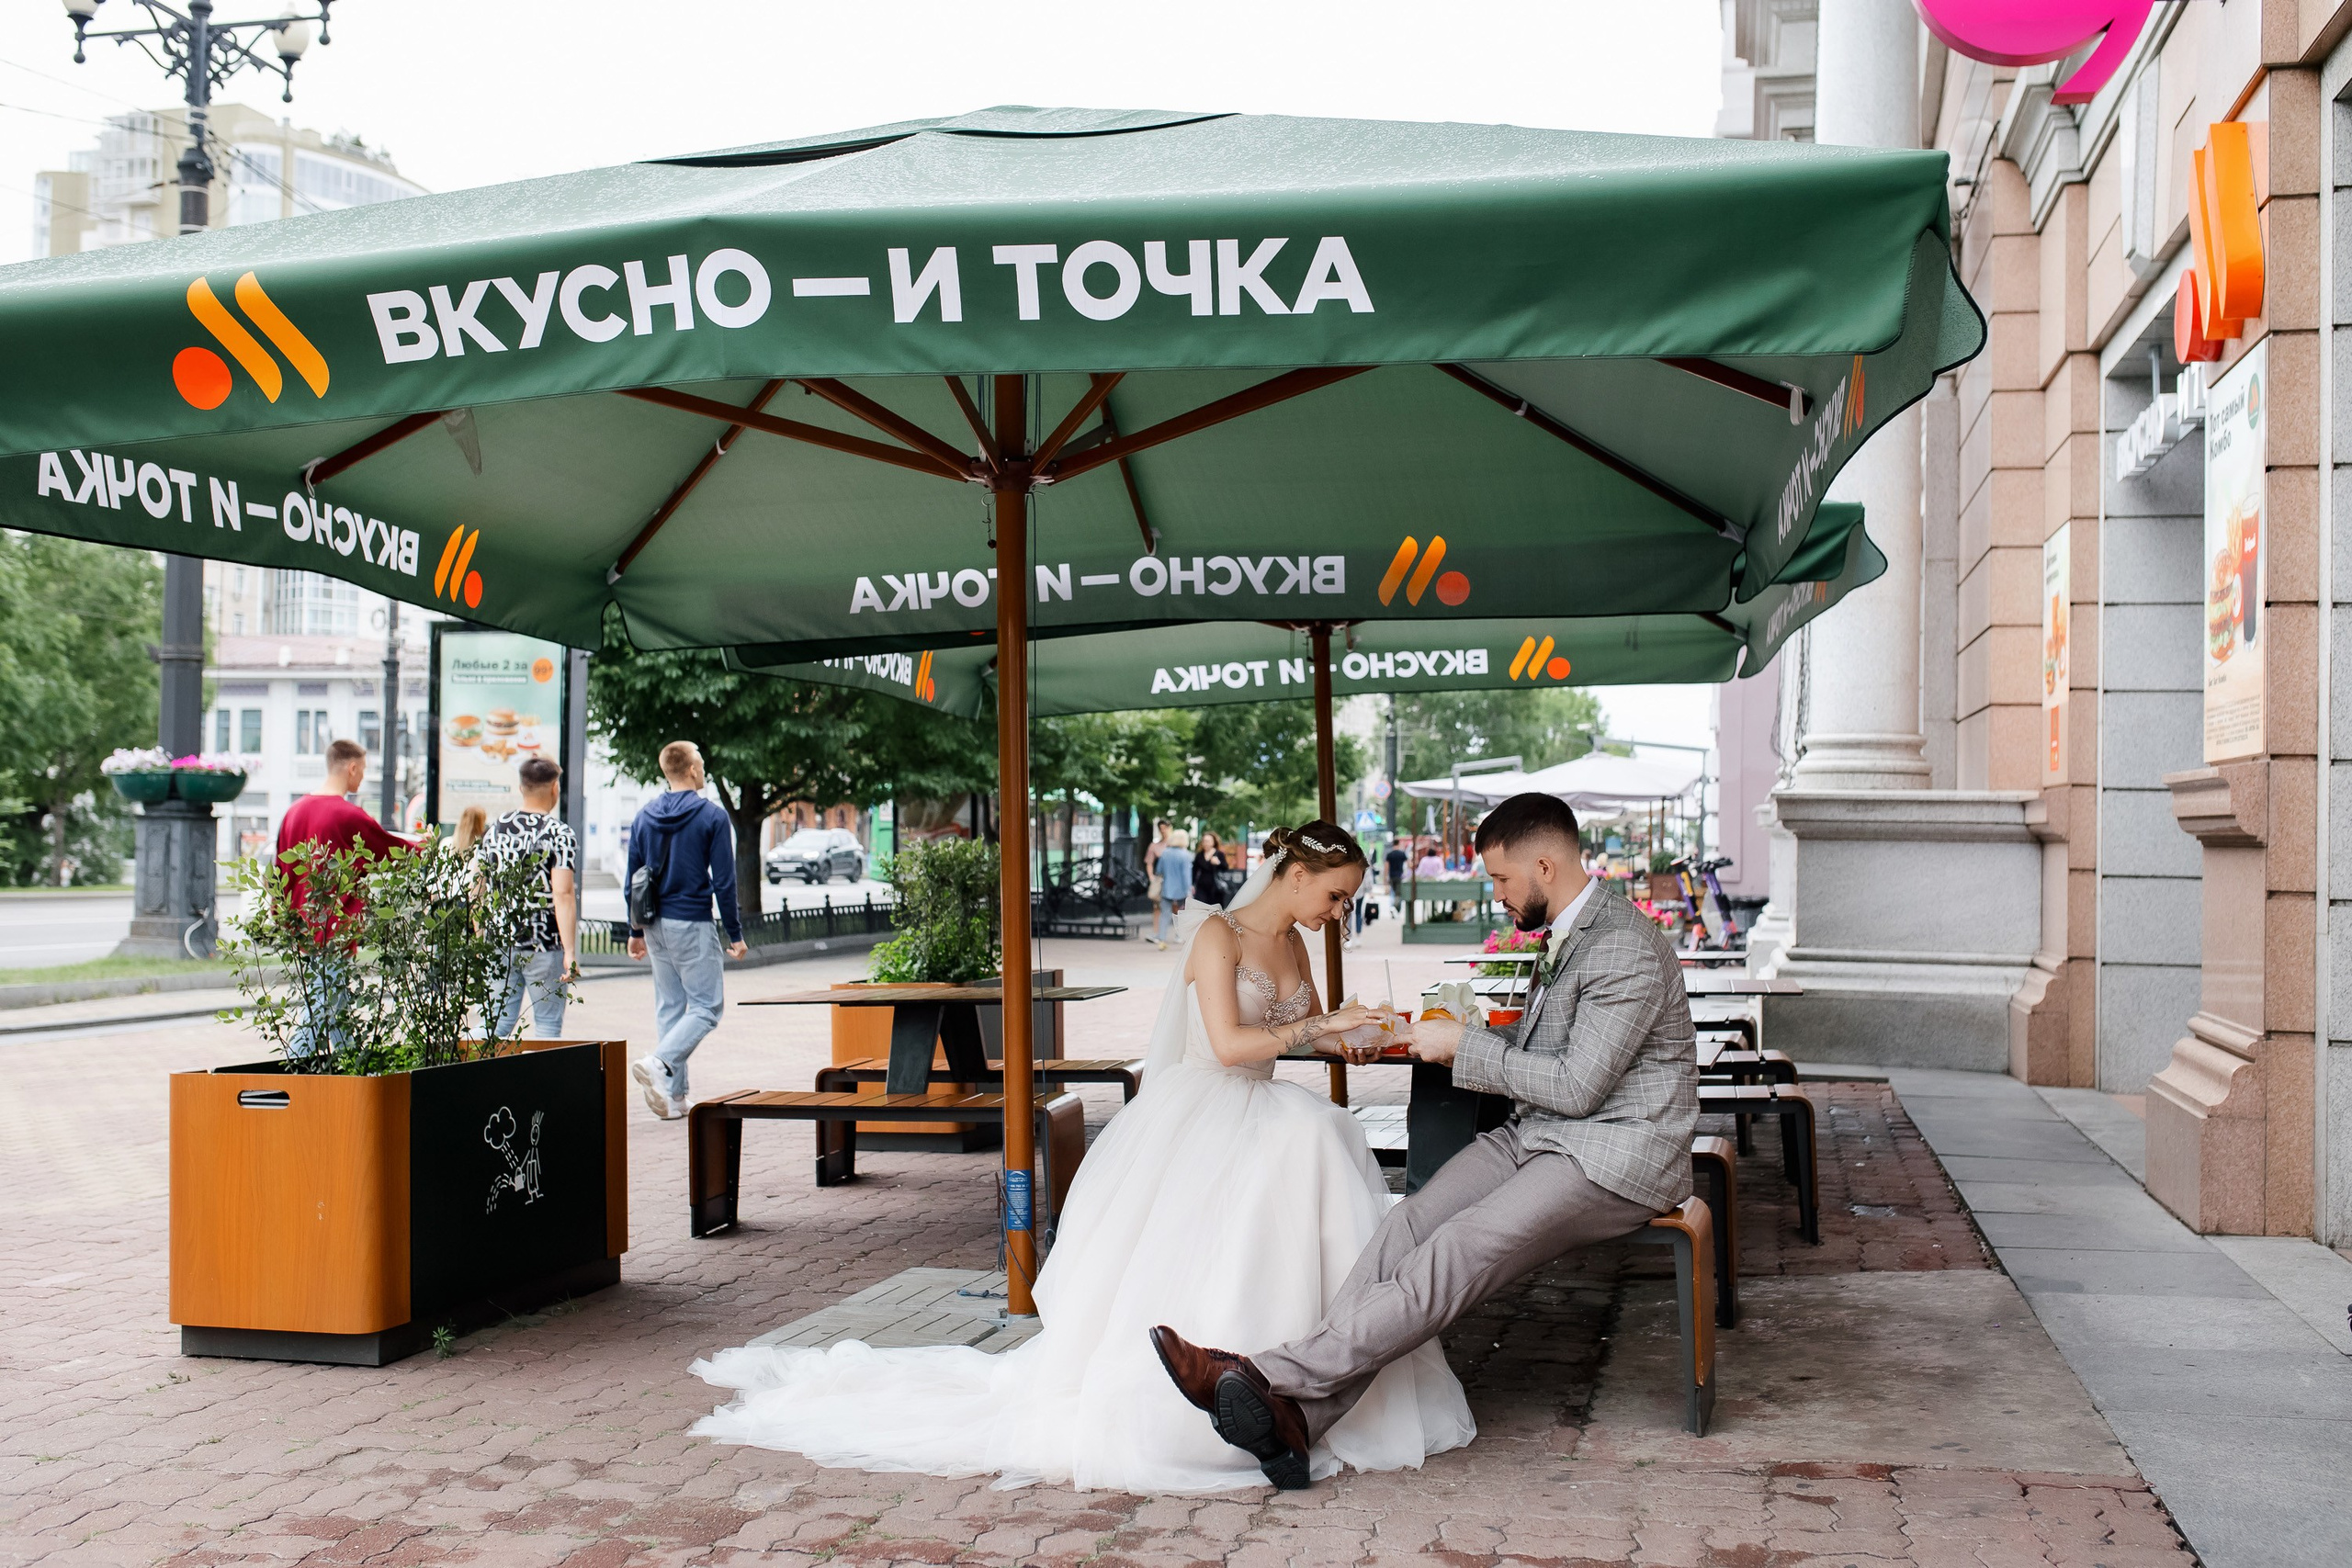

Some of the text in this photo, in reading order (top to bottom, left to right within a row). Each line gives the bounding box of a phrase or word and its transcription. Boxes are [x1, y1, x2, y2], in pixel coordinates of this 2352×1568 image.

[366, 248, 772, 365] ВКУСНО
[888, 246, 963, 323] И
[991, 236, 1375, 321] ТОЧКА
[2210, 385, 2245, 435] Тот самый
[2209, 431, 2233, 462] Комбо
[452, 659, 528, 671] Любые 2 за
